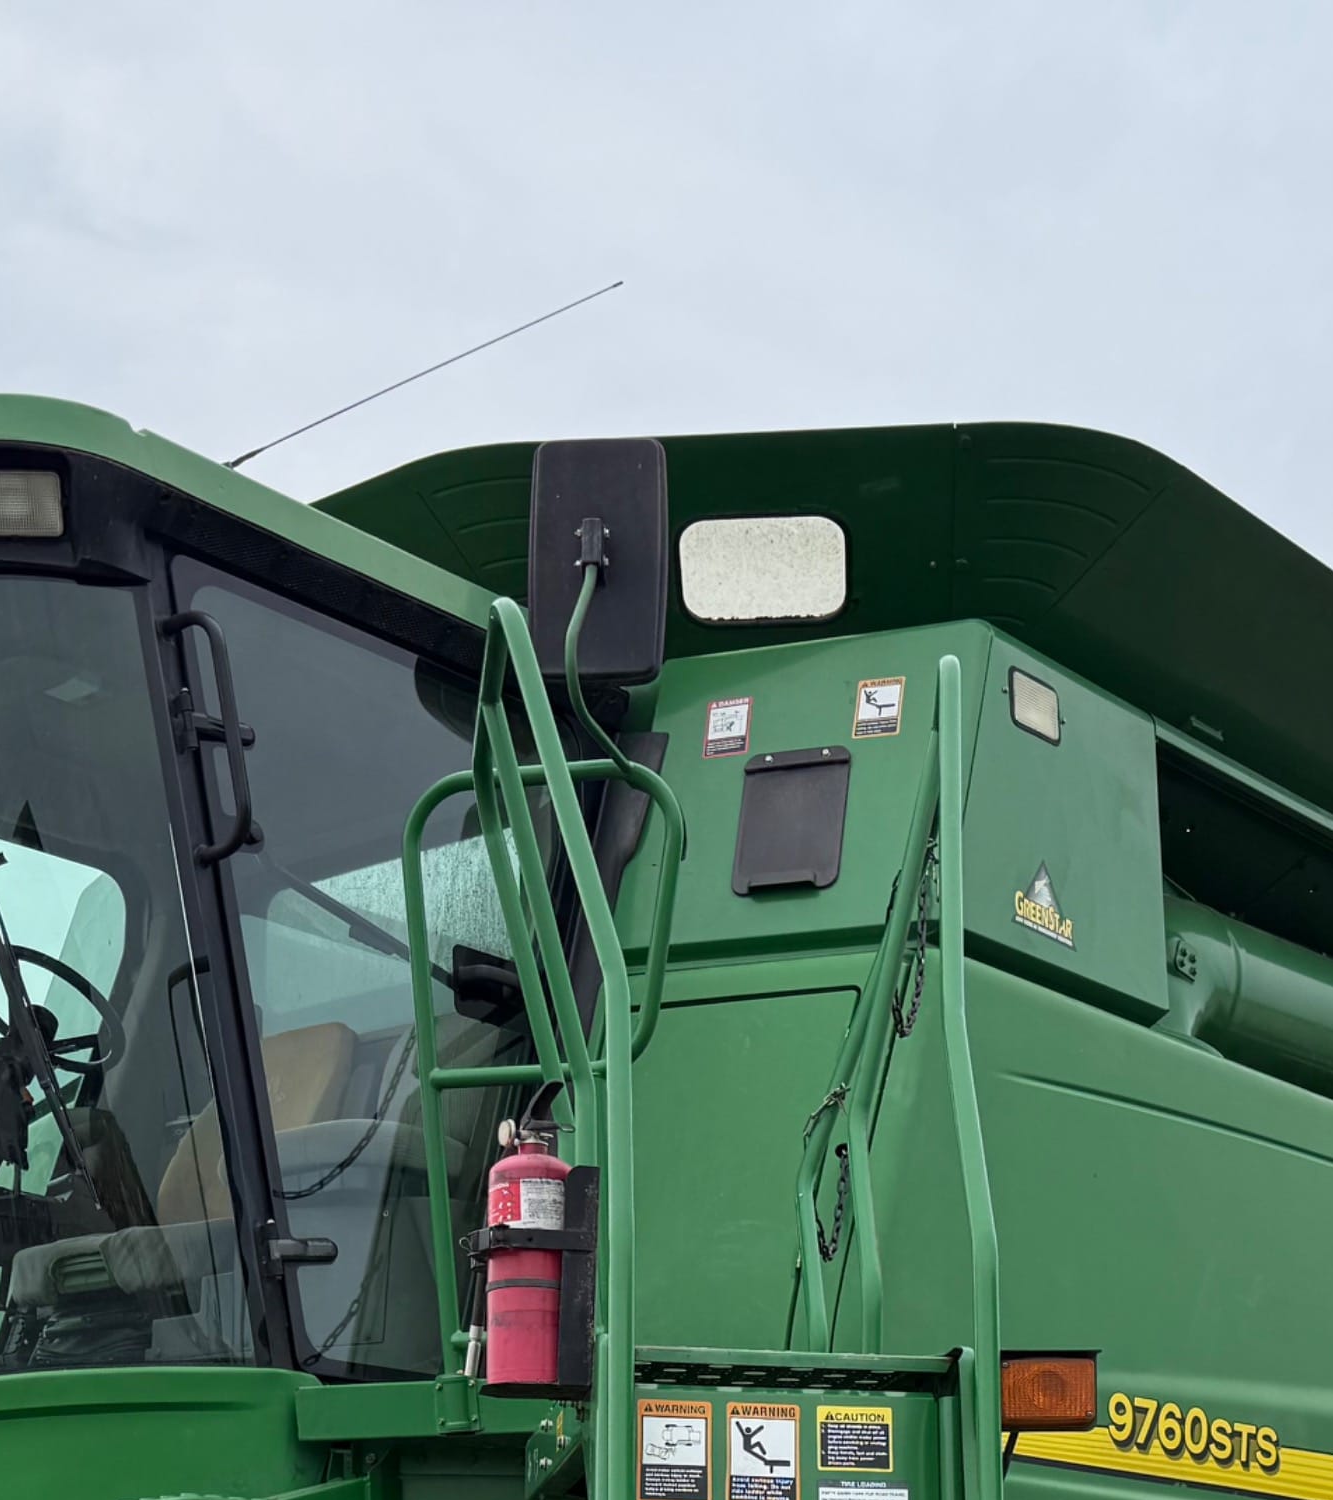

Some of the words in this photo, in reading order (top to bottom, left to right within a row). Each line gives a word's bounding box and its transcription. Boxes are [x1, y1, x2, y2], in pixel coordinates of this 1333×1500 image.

[655, 1404, 706, 1415] WARNING
[741, 1406, 796, 1418] WARNING
[834, 1412, 885, 1422] CAUTION
[1107, 1391, 1281, 1474] 9760STS
